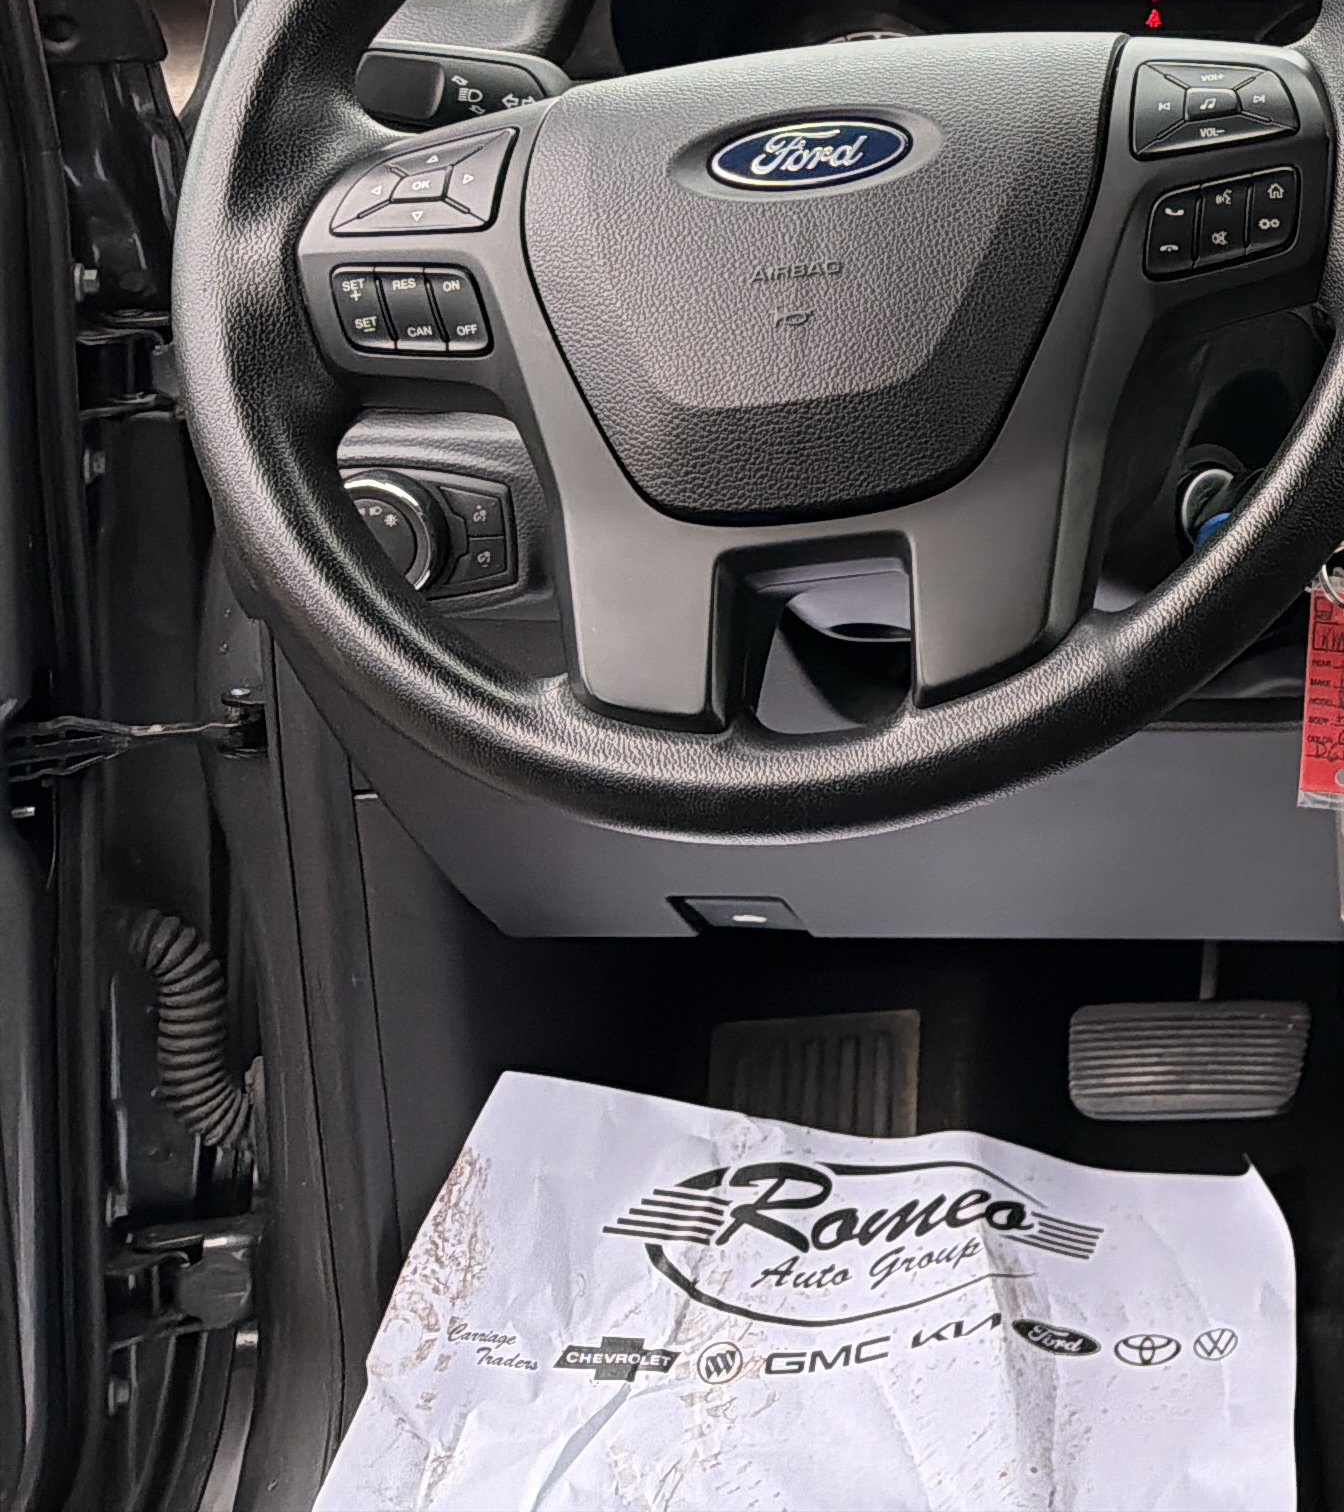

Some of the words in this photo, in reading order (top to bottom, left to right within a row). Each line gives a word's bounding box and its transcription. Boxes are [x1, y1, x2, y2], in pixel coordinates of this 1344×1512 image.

[749, 127, 869, 176] Ford
[411, 178, 431, 191] OK
[749, 261, 843, 284] AIRBAG
[341, 279, 365, 292] SET
[391, 278, 417, 291] RES
[442, 279, 461, 293] ON
[354, 316, 377, 330] SET
[407, 324, 434, 338] CAN
[456, 324, 478, 338] OFF
[714, 1162, 1036, 1256] Romeo
[750, 1259, 853, 1291] Auto
[868, 1236, 985, 1286] Group
[446, 1322, 518, 1347] Carriage
[1027, 1324, 1084, 1355] Ford
[475, 1346, 539, 1372] Traders
[564, 1349, 673, 1368] CHEVROLET
[764, 1334, 891, 1376] GMC
